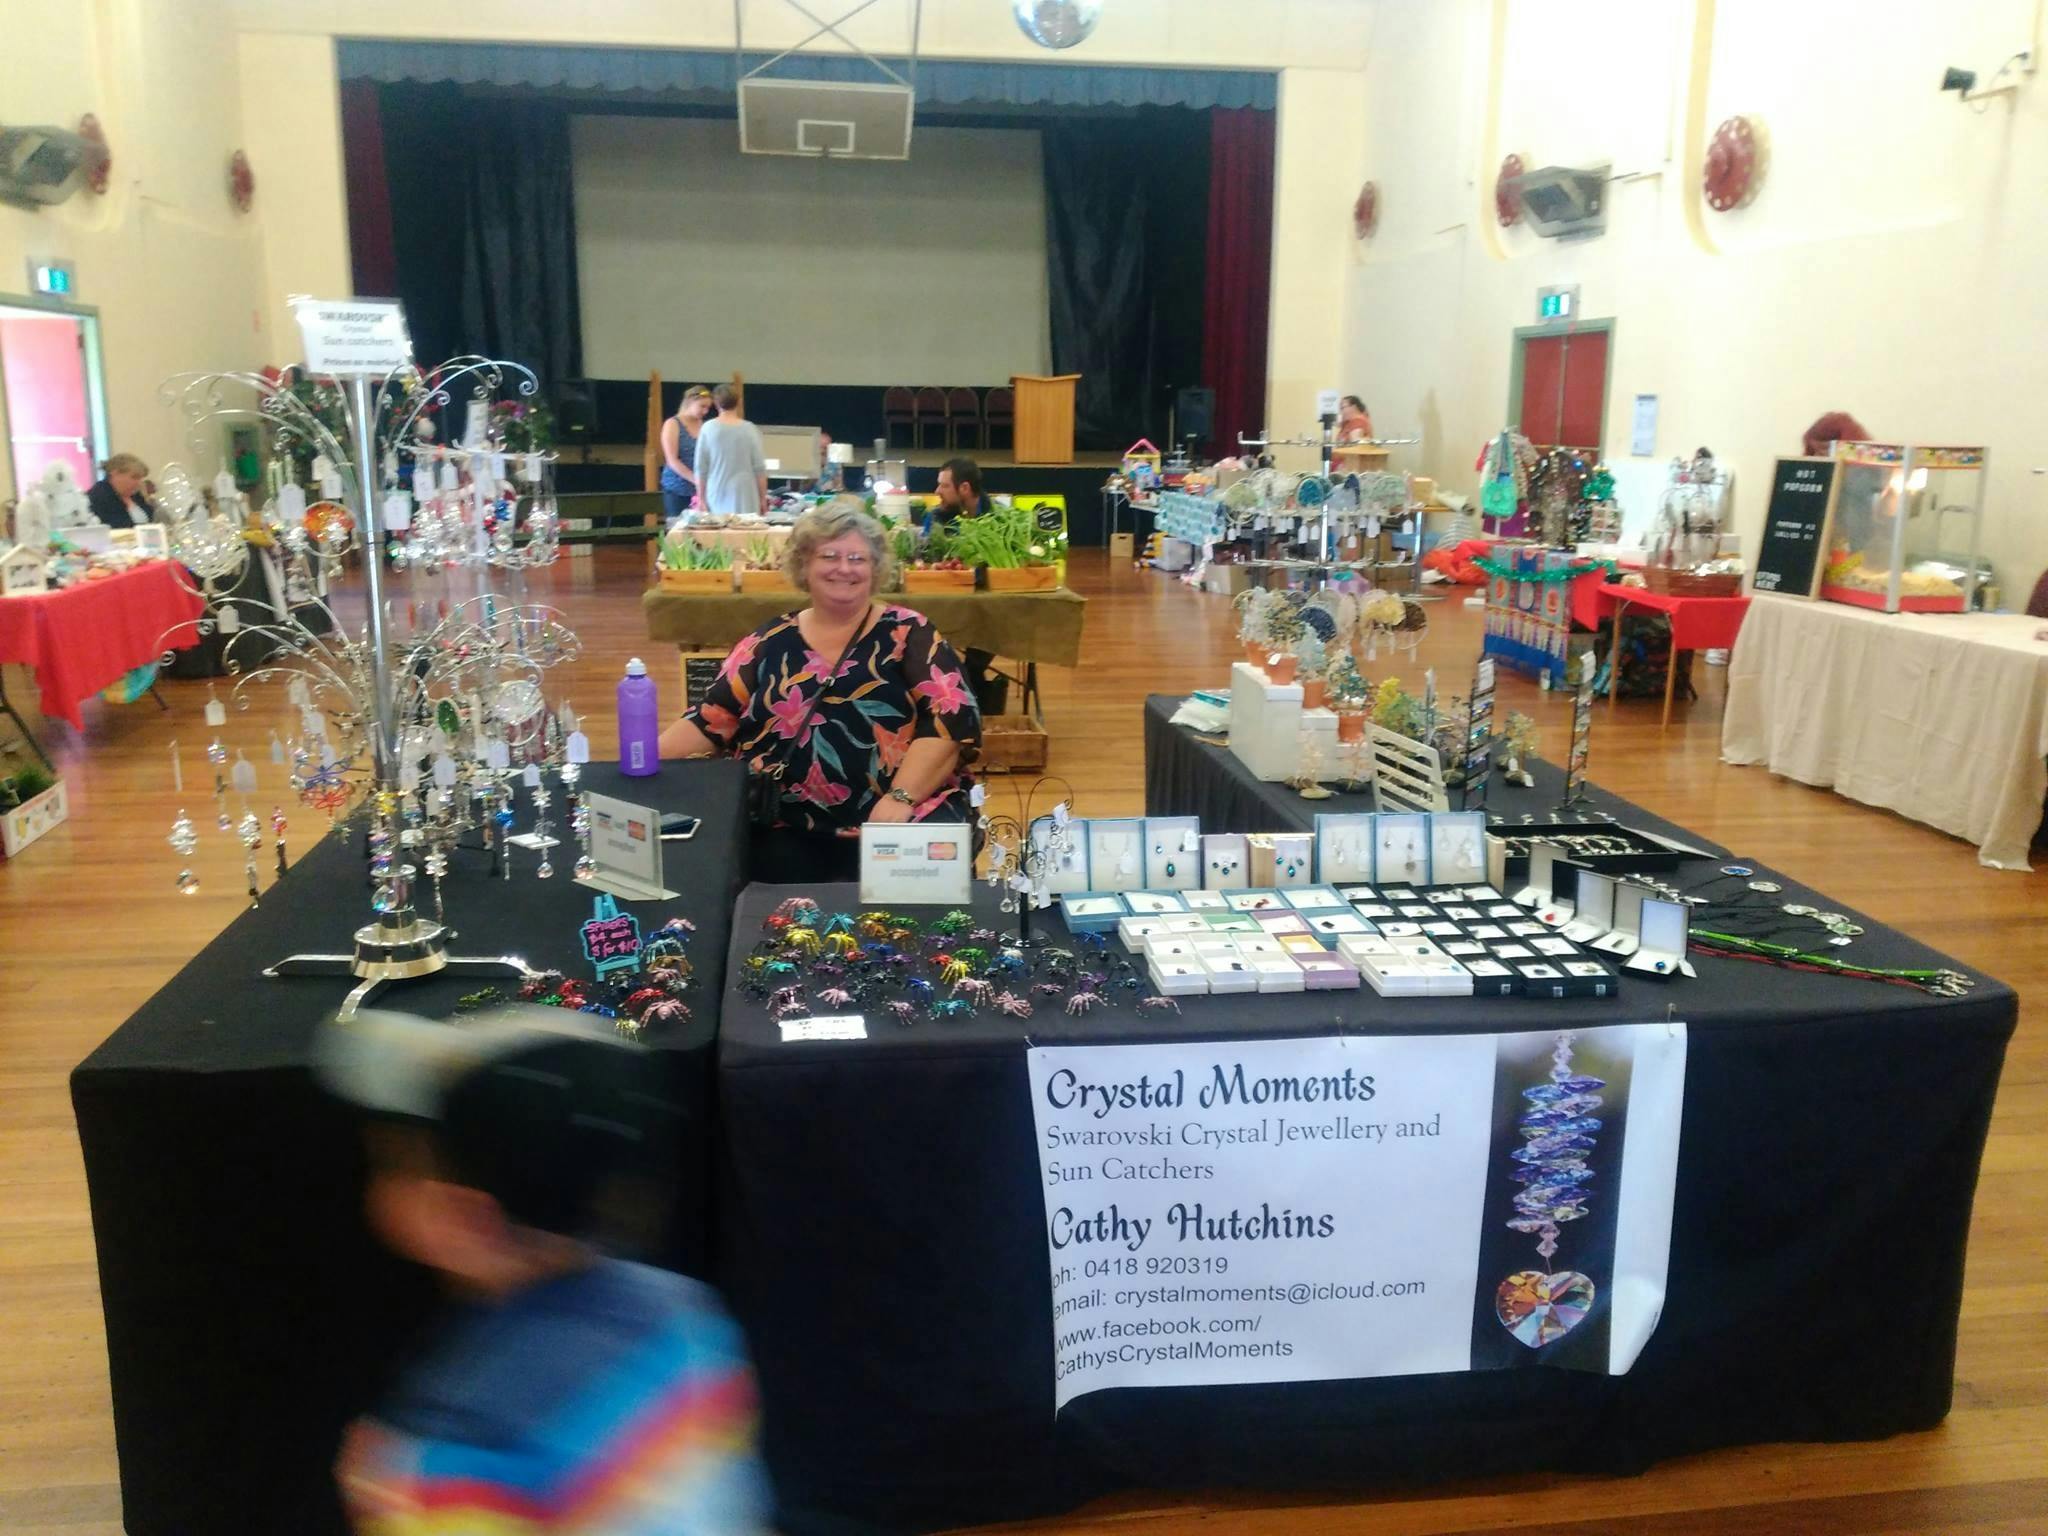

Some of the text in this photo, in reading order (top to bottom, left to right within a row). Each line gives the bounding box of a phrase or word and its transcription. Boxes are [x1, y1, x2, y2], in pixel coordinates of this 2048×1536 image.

[877, 847, 896, 855] VISA
[903, 846, 923, 856] and
[889, 867, 939, 880] accepted
[1046, 1063, 1377, 1119] Crystal Moments
[1046, 1113, 1441, 1150] Swarovski Crystal Jewellery and
[1047, 1157, 1214, 1186] Sun Catchers
[1050, 1202, 1336, 1252] Cathy Hutchins
[1084, 1258, 1139, 1278] 0418
[1146, 1256, 1229, 1275] 920319
[1053, 1280, 1426, 1321] email: crystalmoments@icloud.com
[1055, 1338, 1294, 1381] CathysCrystalMoments
